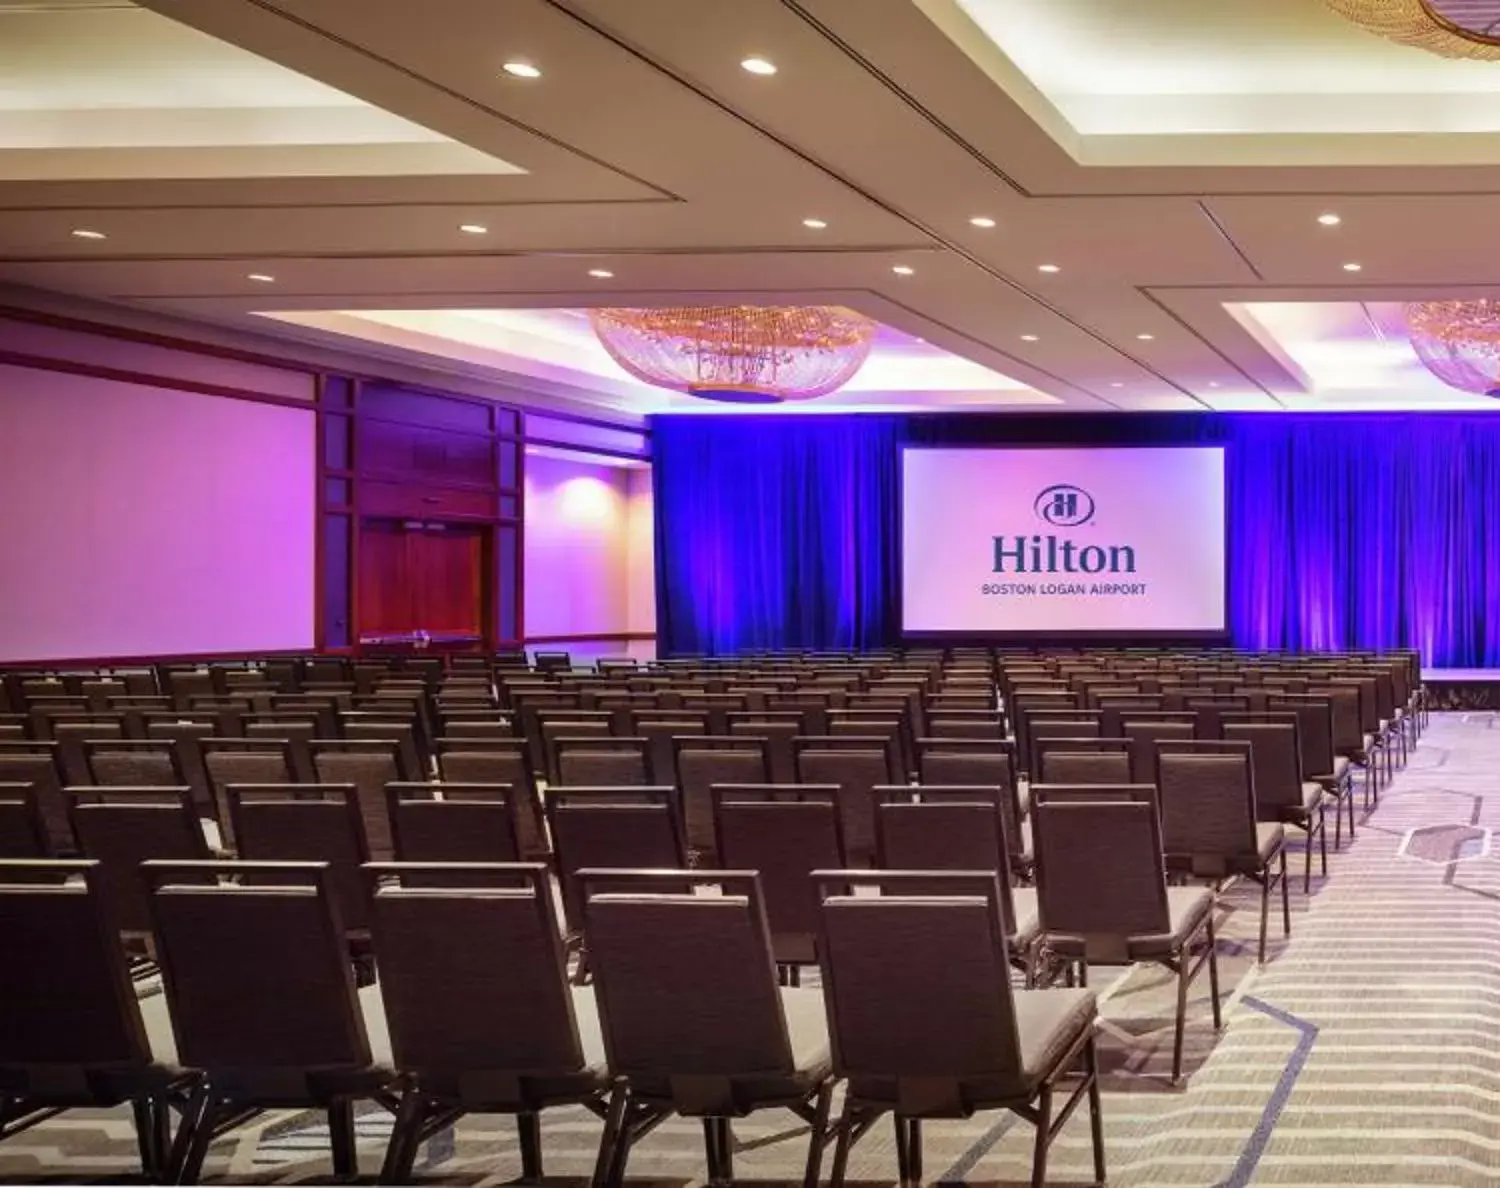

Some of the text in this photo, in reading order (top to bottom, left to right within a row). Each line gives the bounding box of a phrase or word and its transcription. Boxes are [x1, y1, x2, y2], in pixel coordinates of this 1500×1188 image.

[991, 535, 1137, 573] Hilton
[982, 583, 1147, 595] BOSTON LOGAN AIRPORT
